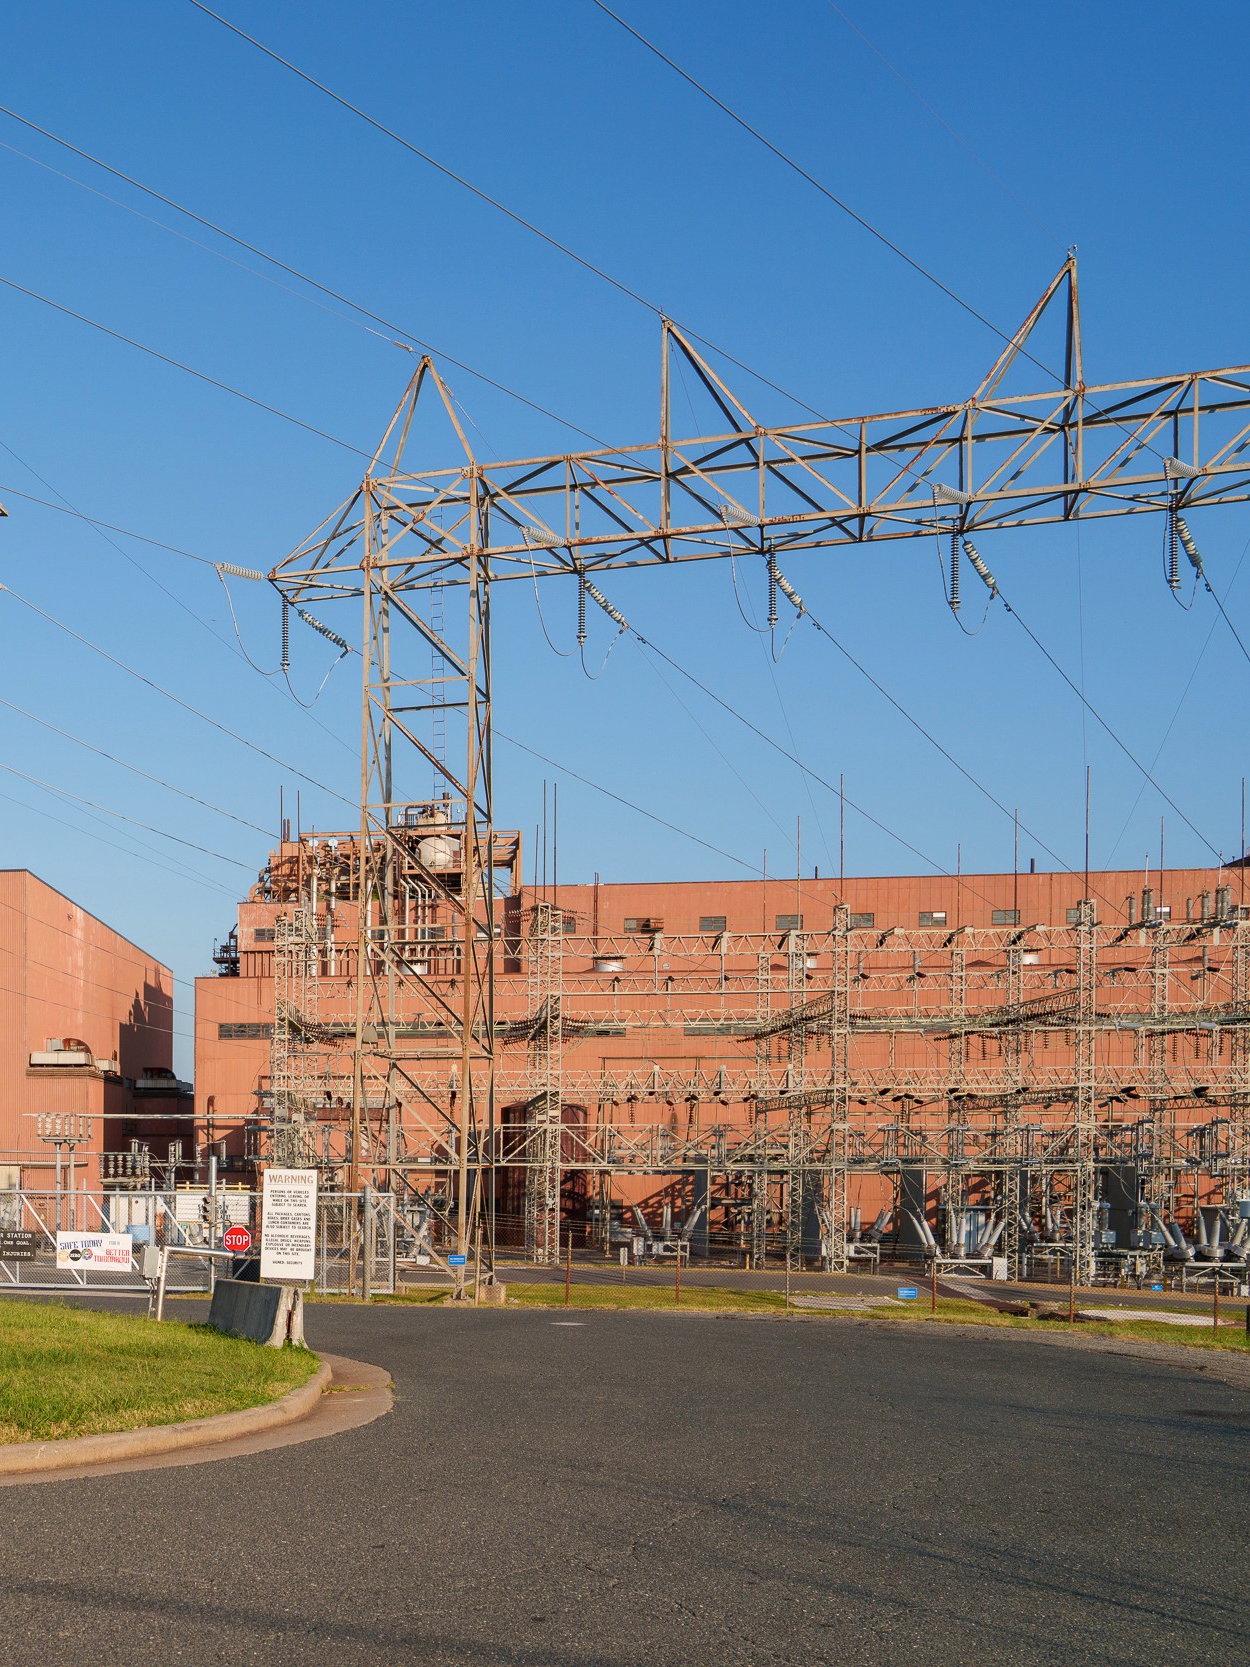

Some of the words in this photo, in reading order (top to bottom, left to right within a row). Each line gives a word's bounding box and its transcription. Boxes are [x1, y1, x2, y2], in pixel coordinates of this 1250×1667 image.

[268, 1174, 314, 1184] WARNING
[60, 1241, 79, 1250] SAFE
[80, 1239, 103, 1248] TODAY
[225, 1236, 249, 1245] STOP
[94, 1255, 130, 1264] TOMORROW
